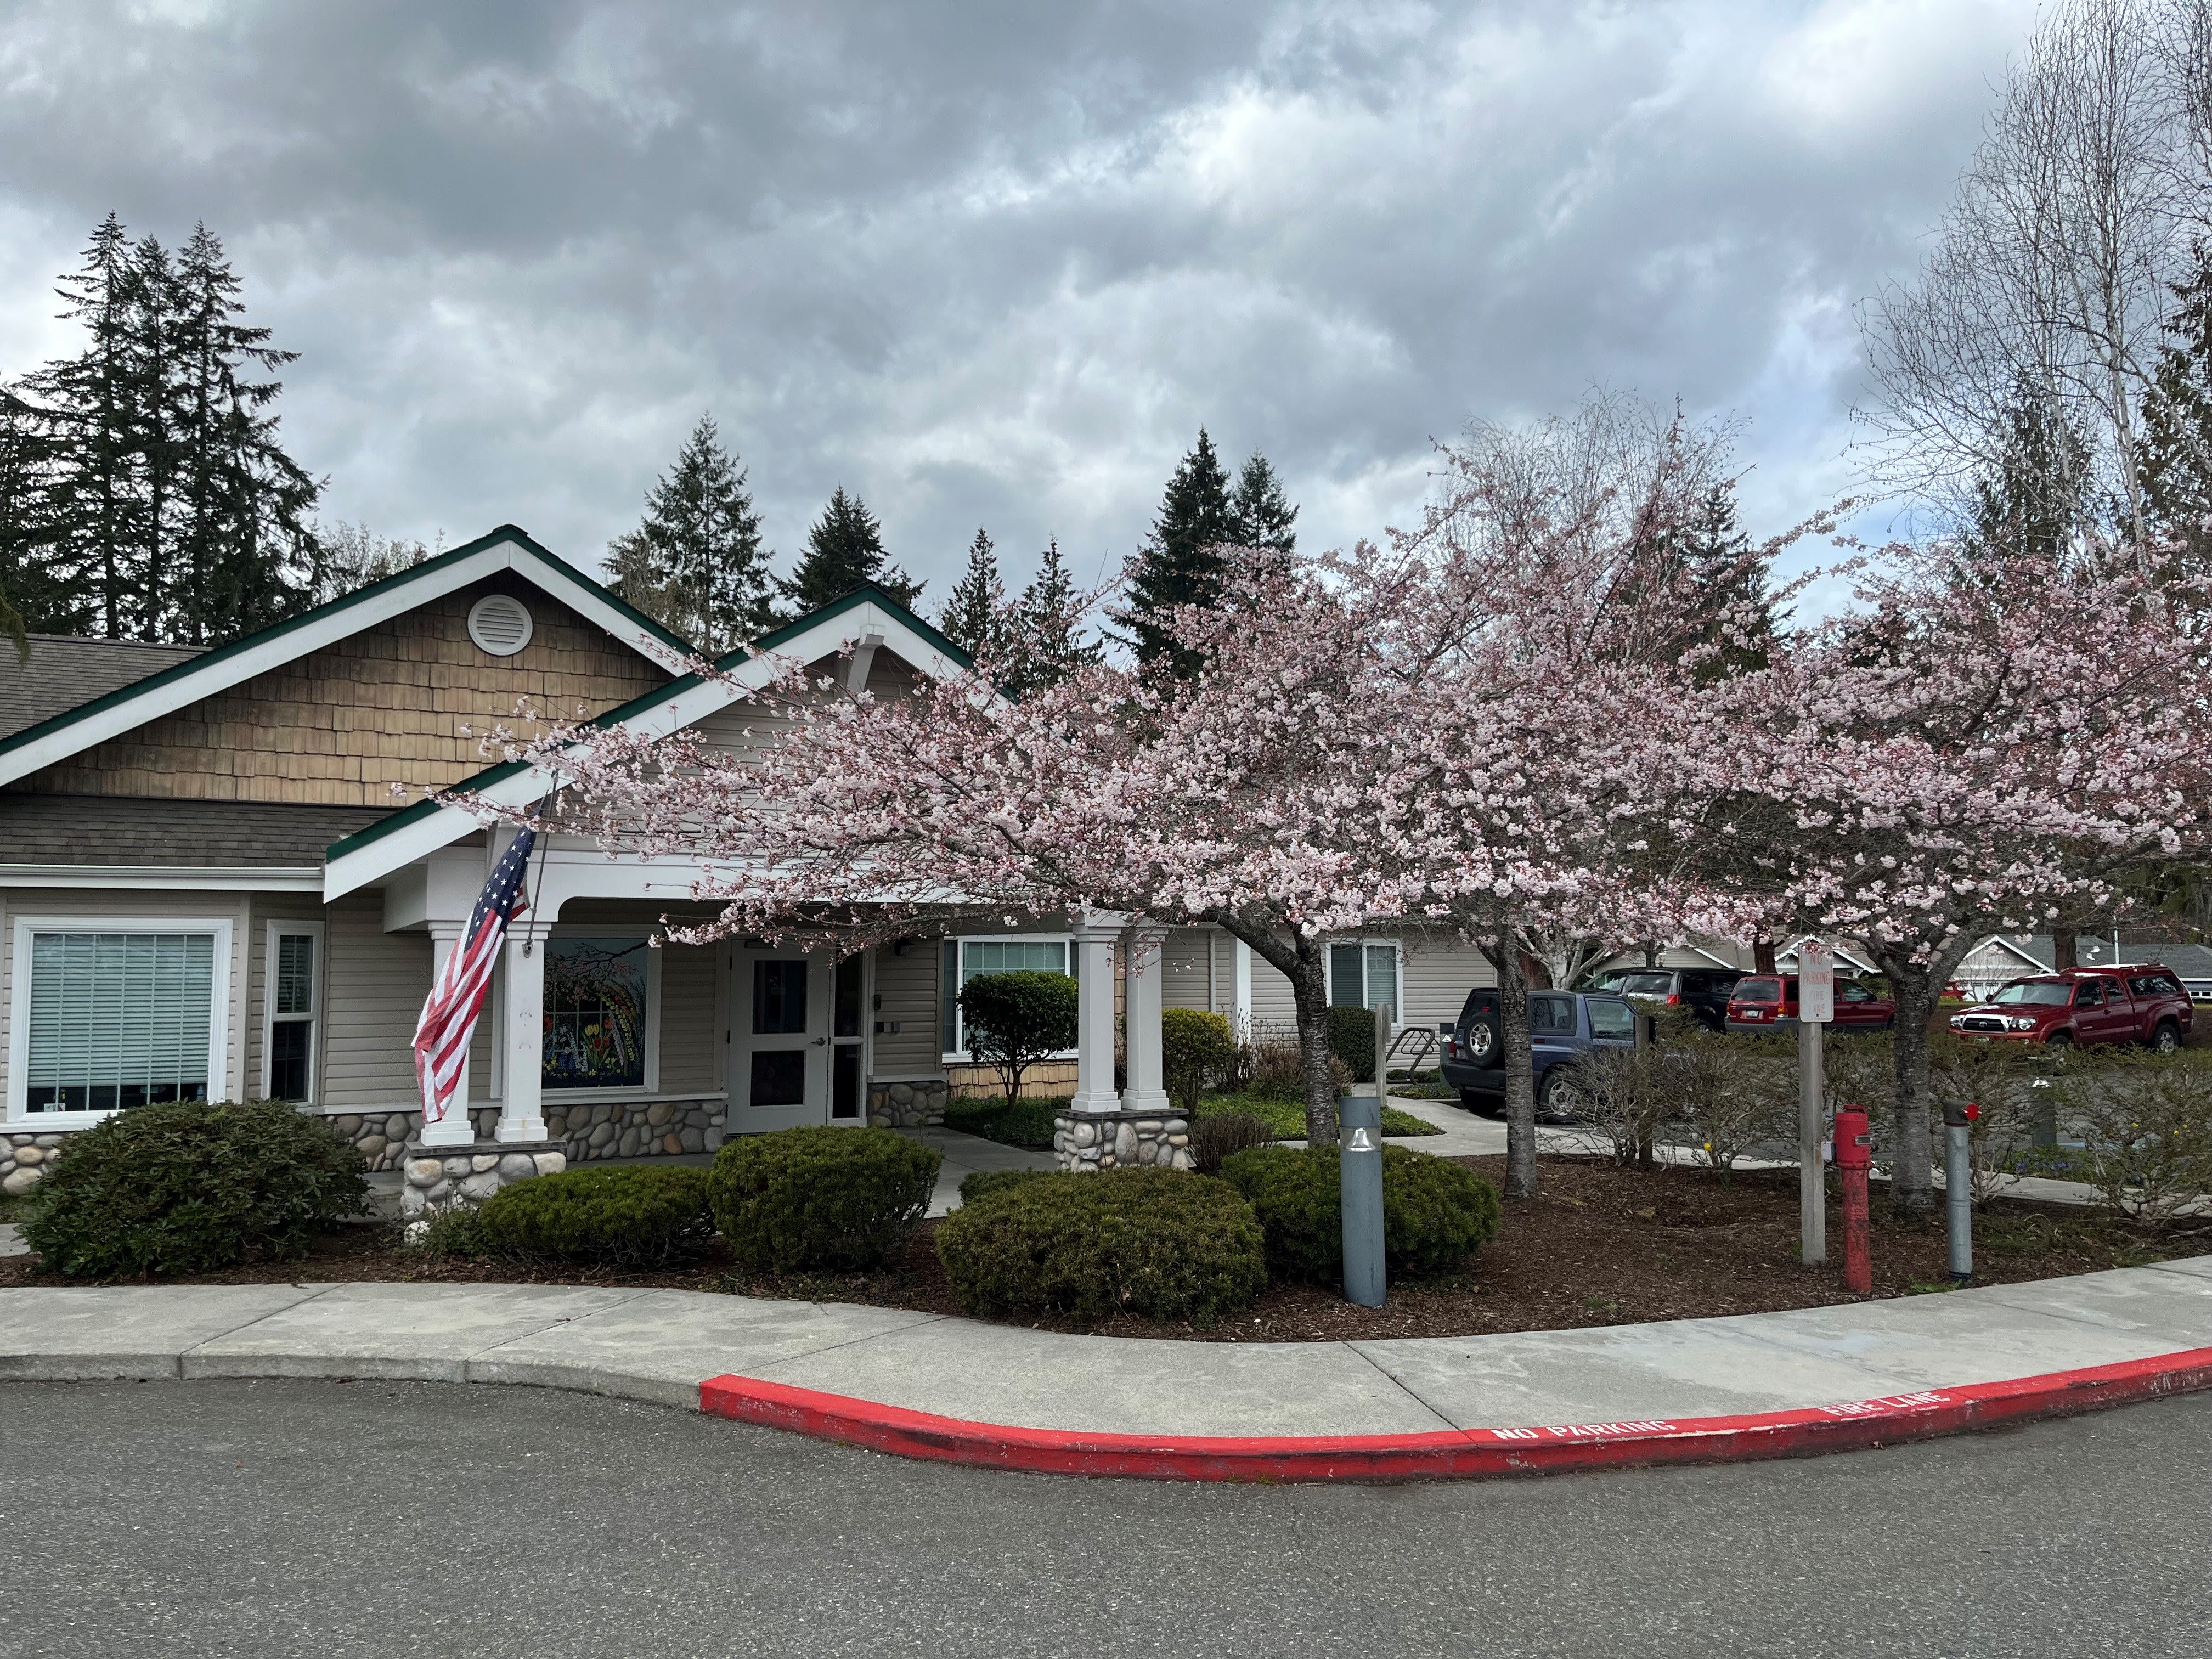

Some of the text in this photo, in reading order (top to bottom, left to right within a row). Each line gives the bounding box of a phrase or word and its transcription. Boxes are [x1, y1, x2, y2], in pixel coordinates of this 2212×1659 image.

[1810, 952, 1823, 965] NO
[1803, 971, 1830, 984] PARKING
[1818, 1392, 1951, 1416] FIRE LANE
[1490, 1421, 1677, 1440] NO PARKING
